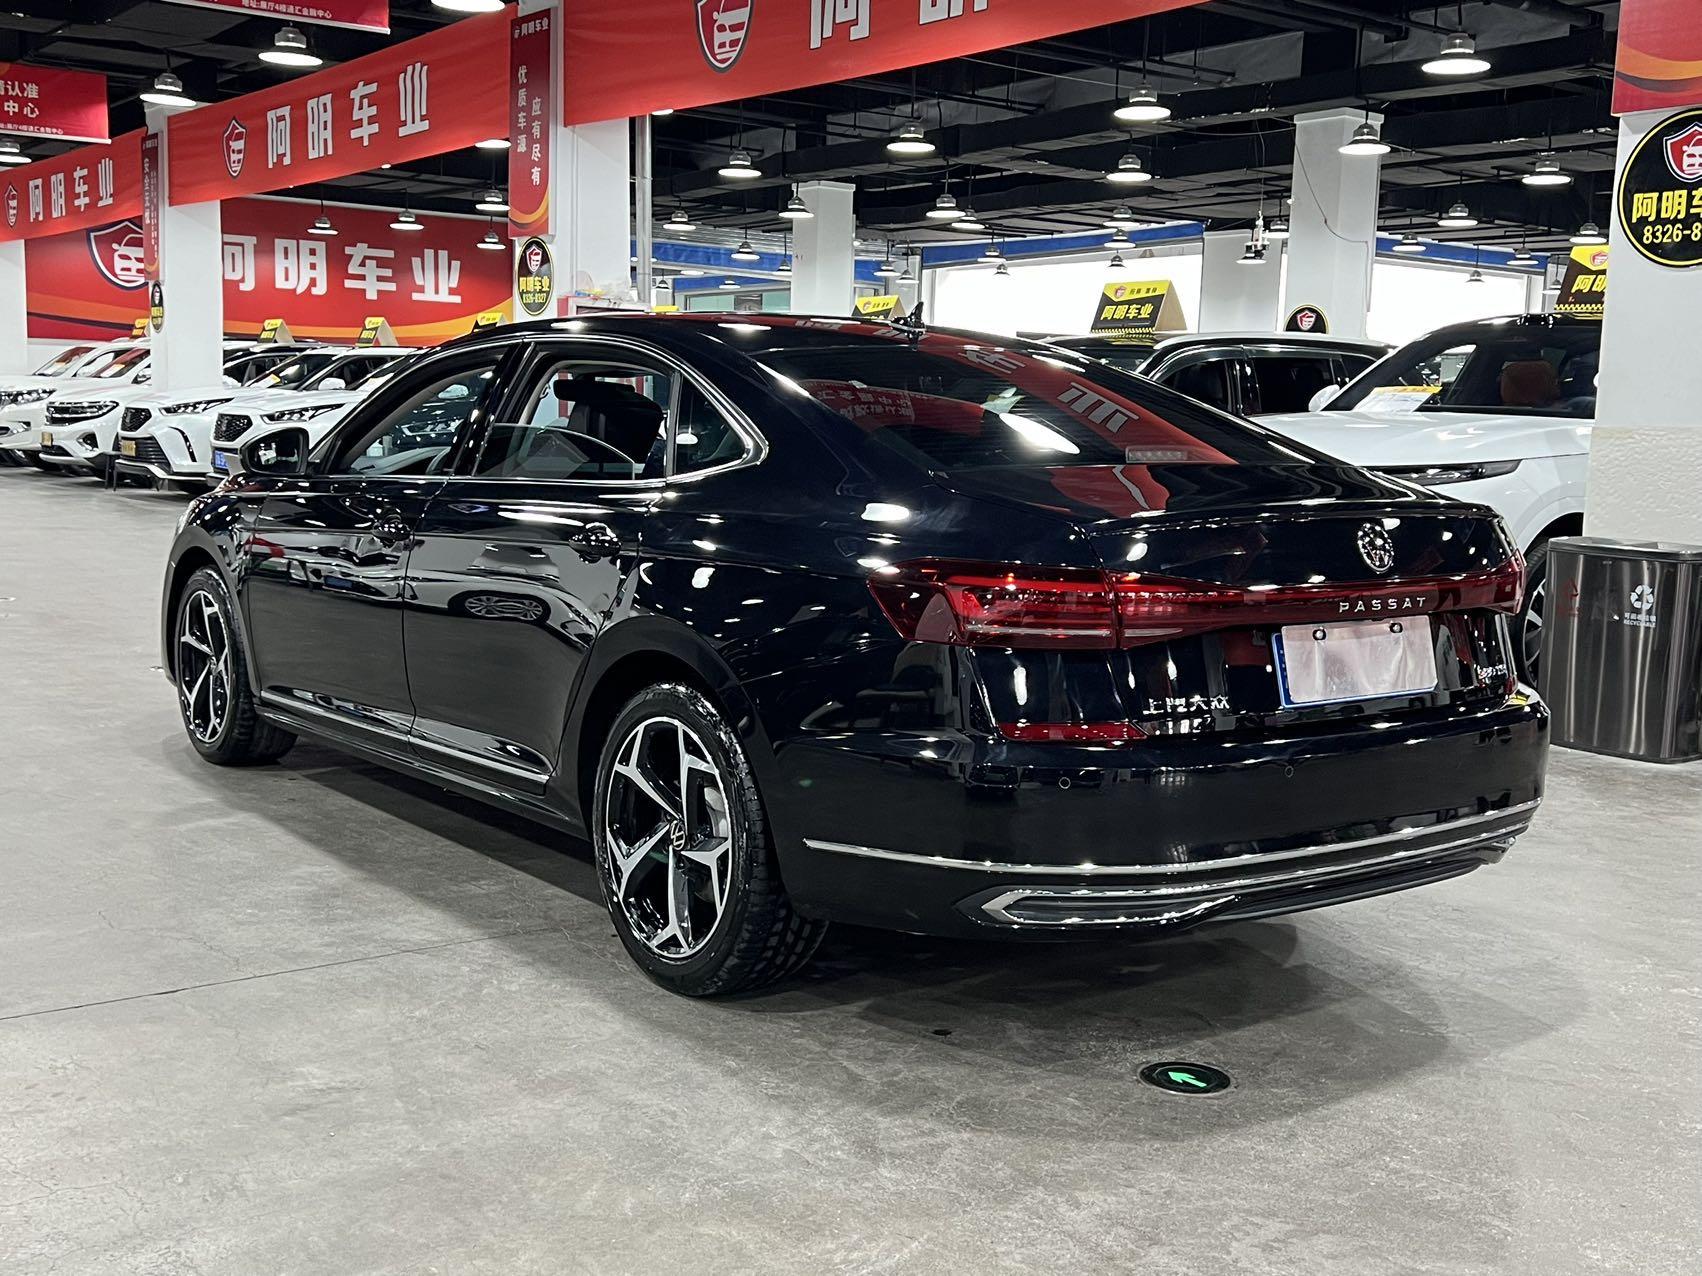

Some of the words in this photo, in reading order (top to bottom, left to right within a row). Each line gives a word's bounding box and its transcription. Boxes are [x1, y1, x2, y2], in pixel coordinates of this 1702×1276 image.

[521, 17, 549, 36] 阿明车业
[4, 100, 39, 118] 中心
[266, 62, 430, 169] 阿明车业
[517, 65, 528, 153] 优质车源
[531, 97, 542, 186] 应有尽有
[28, 158, 114, 223] 阿明车业
[1642, 221, 1702, 244] 8326-8
[519, 275, 550, 293] 阿明车业
[1100, 303, 1154, 321] 阿明车业
[1339, 597, 1426, 613] PASSAT
